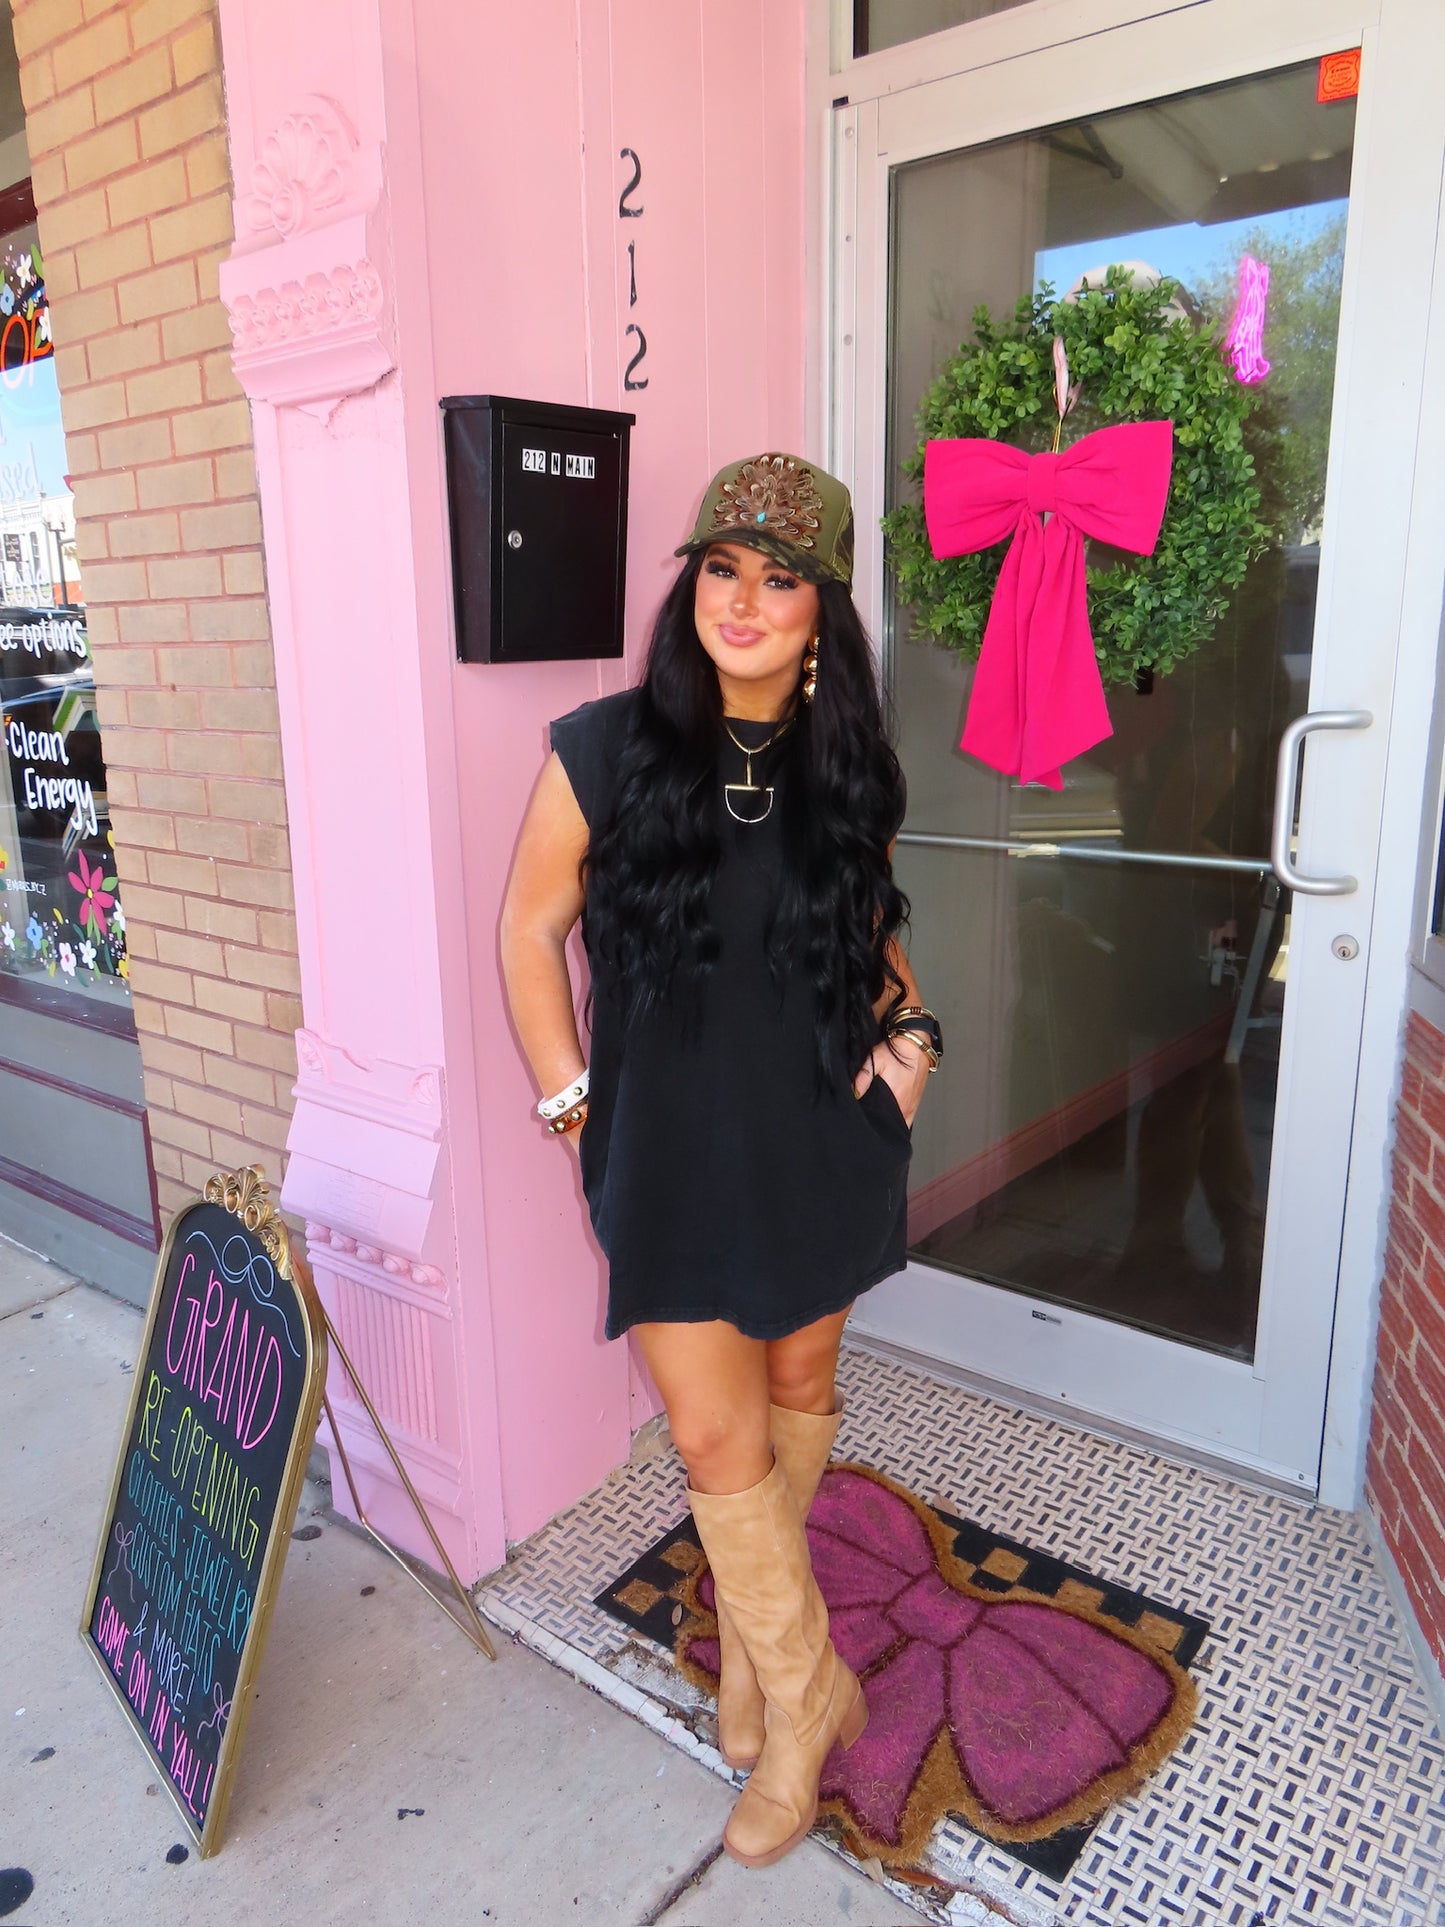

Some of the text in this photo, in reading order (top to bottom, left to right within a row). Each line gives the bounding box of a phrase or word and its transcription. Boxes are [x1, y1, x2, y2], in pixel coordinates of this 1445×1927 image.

[618, 147, 649, 391] 212
[523, 450, 595, 477] 212 N MAIN
[22, 611, 87, 659] options
[9, 721, 70, 766] Clean
[24, 767, 98, 837] Energy
[165, 1252, 283, 1450] GRAND
[128, 1450, 253, 1654] CLOTHES JEWELRY
[138, 1369, 261, 1572] RE-OPENING
[130, 1522, 221, 1695] CUSTOM HATS
[132, 1601, 196, 1724] & MORE!
[97, 1595, 214, 1820] COME ON IN YALL!
